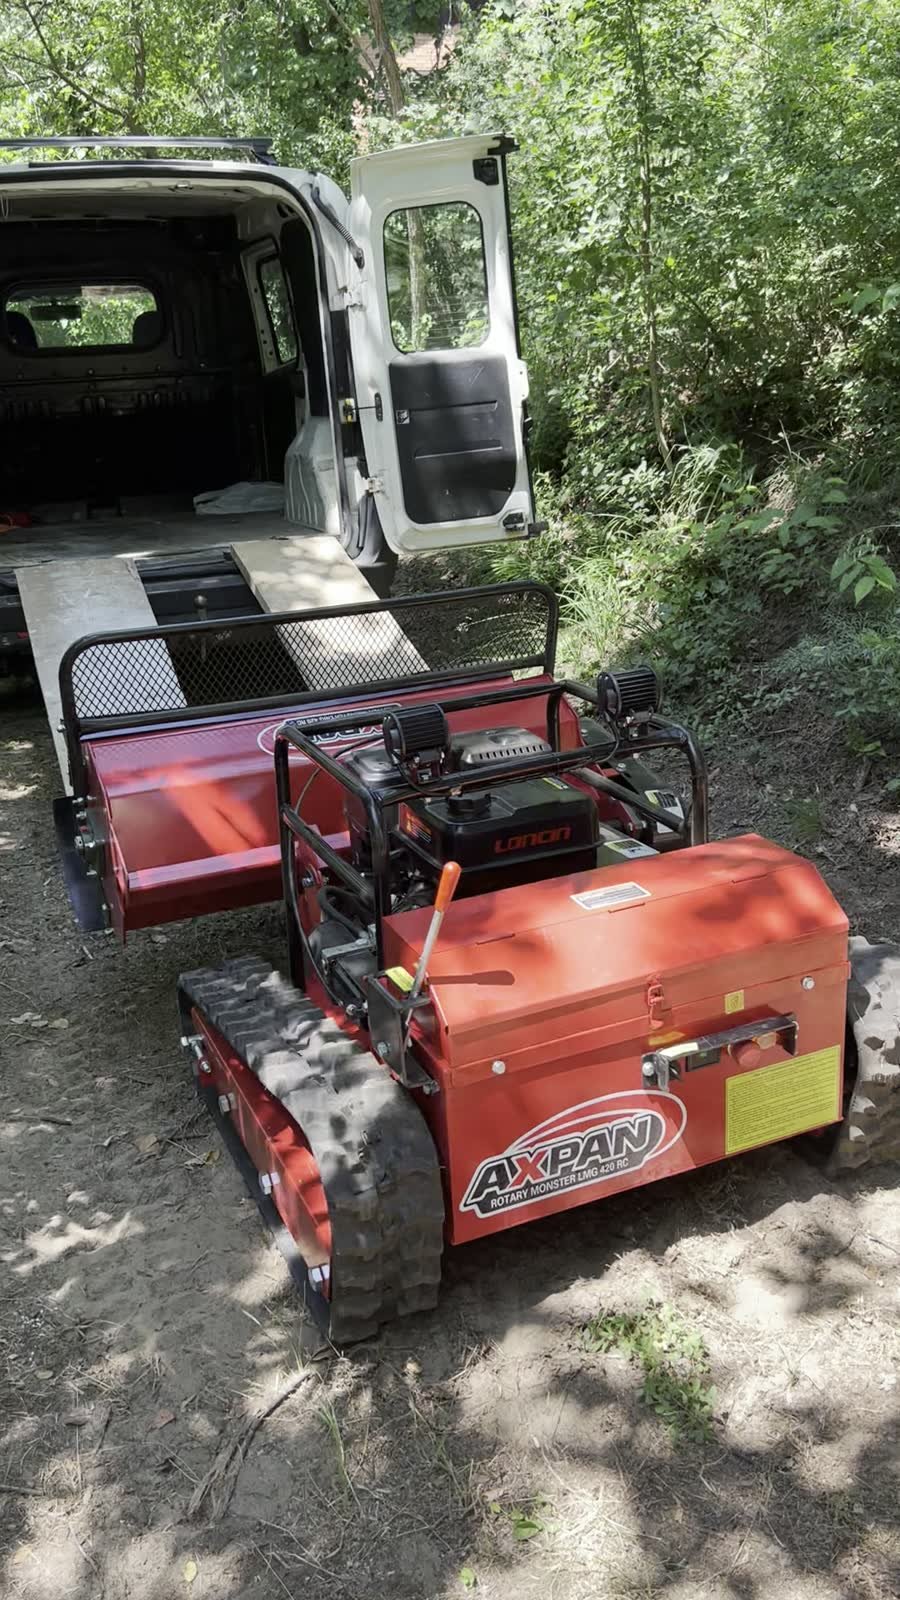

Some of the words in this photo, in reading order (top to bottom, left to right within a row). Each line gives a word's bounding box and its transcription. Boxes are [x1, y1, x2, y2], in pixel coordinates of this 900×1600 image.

[495, 826, 571, 853] LONCIN
[466, 1113, 651, 1204] AXPAN
[490, 1188, 529, 1208] ROTARY
[530, 1174, 576, 1197] MONSTER
[577, 1167, 599, 1182] LMG
[599, 1161, 615, 1175] 420
[616, 1157, 630, 1169] RC
